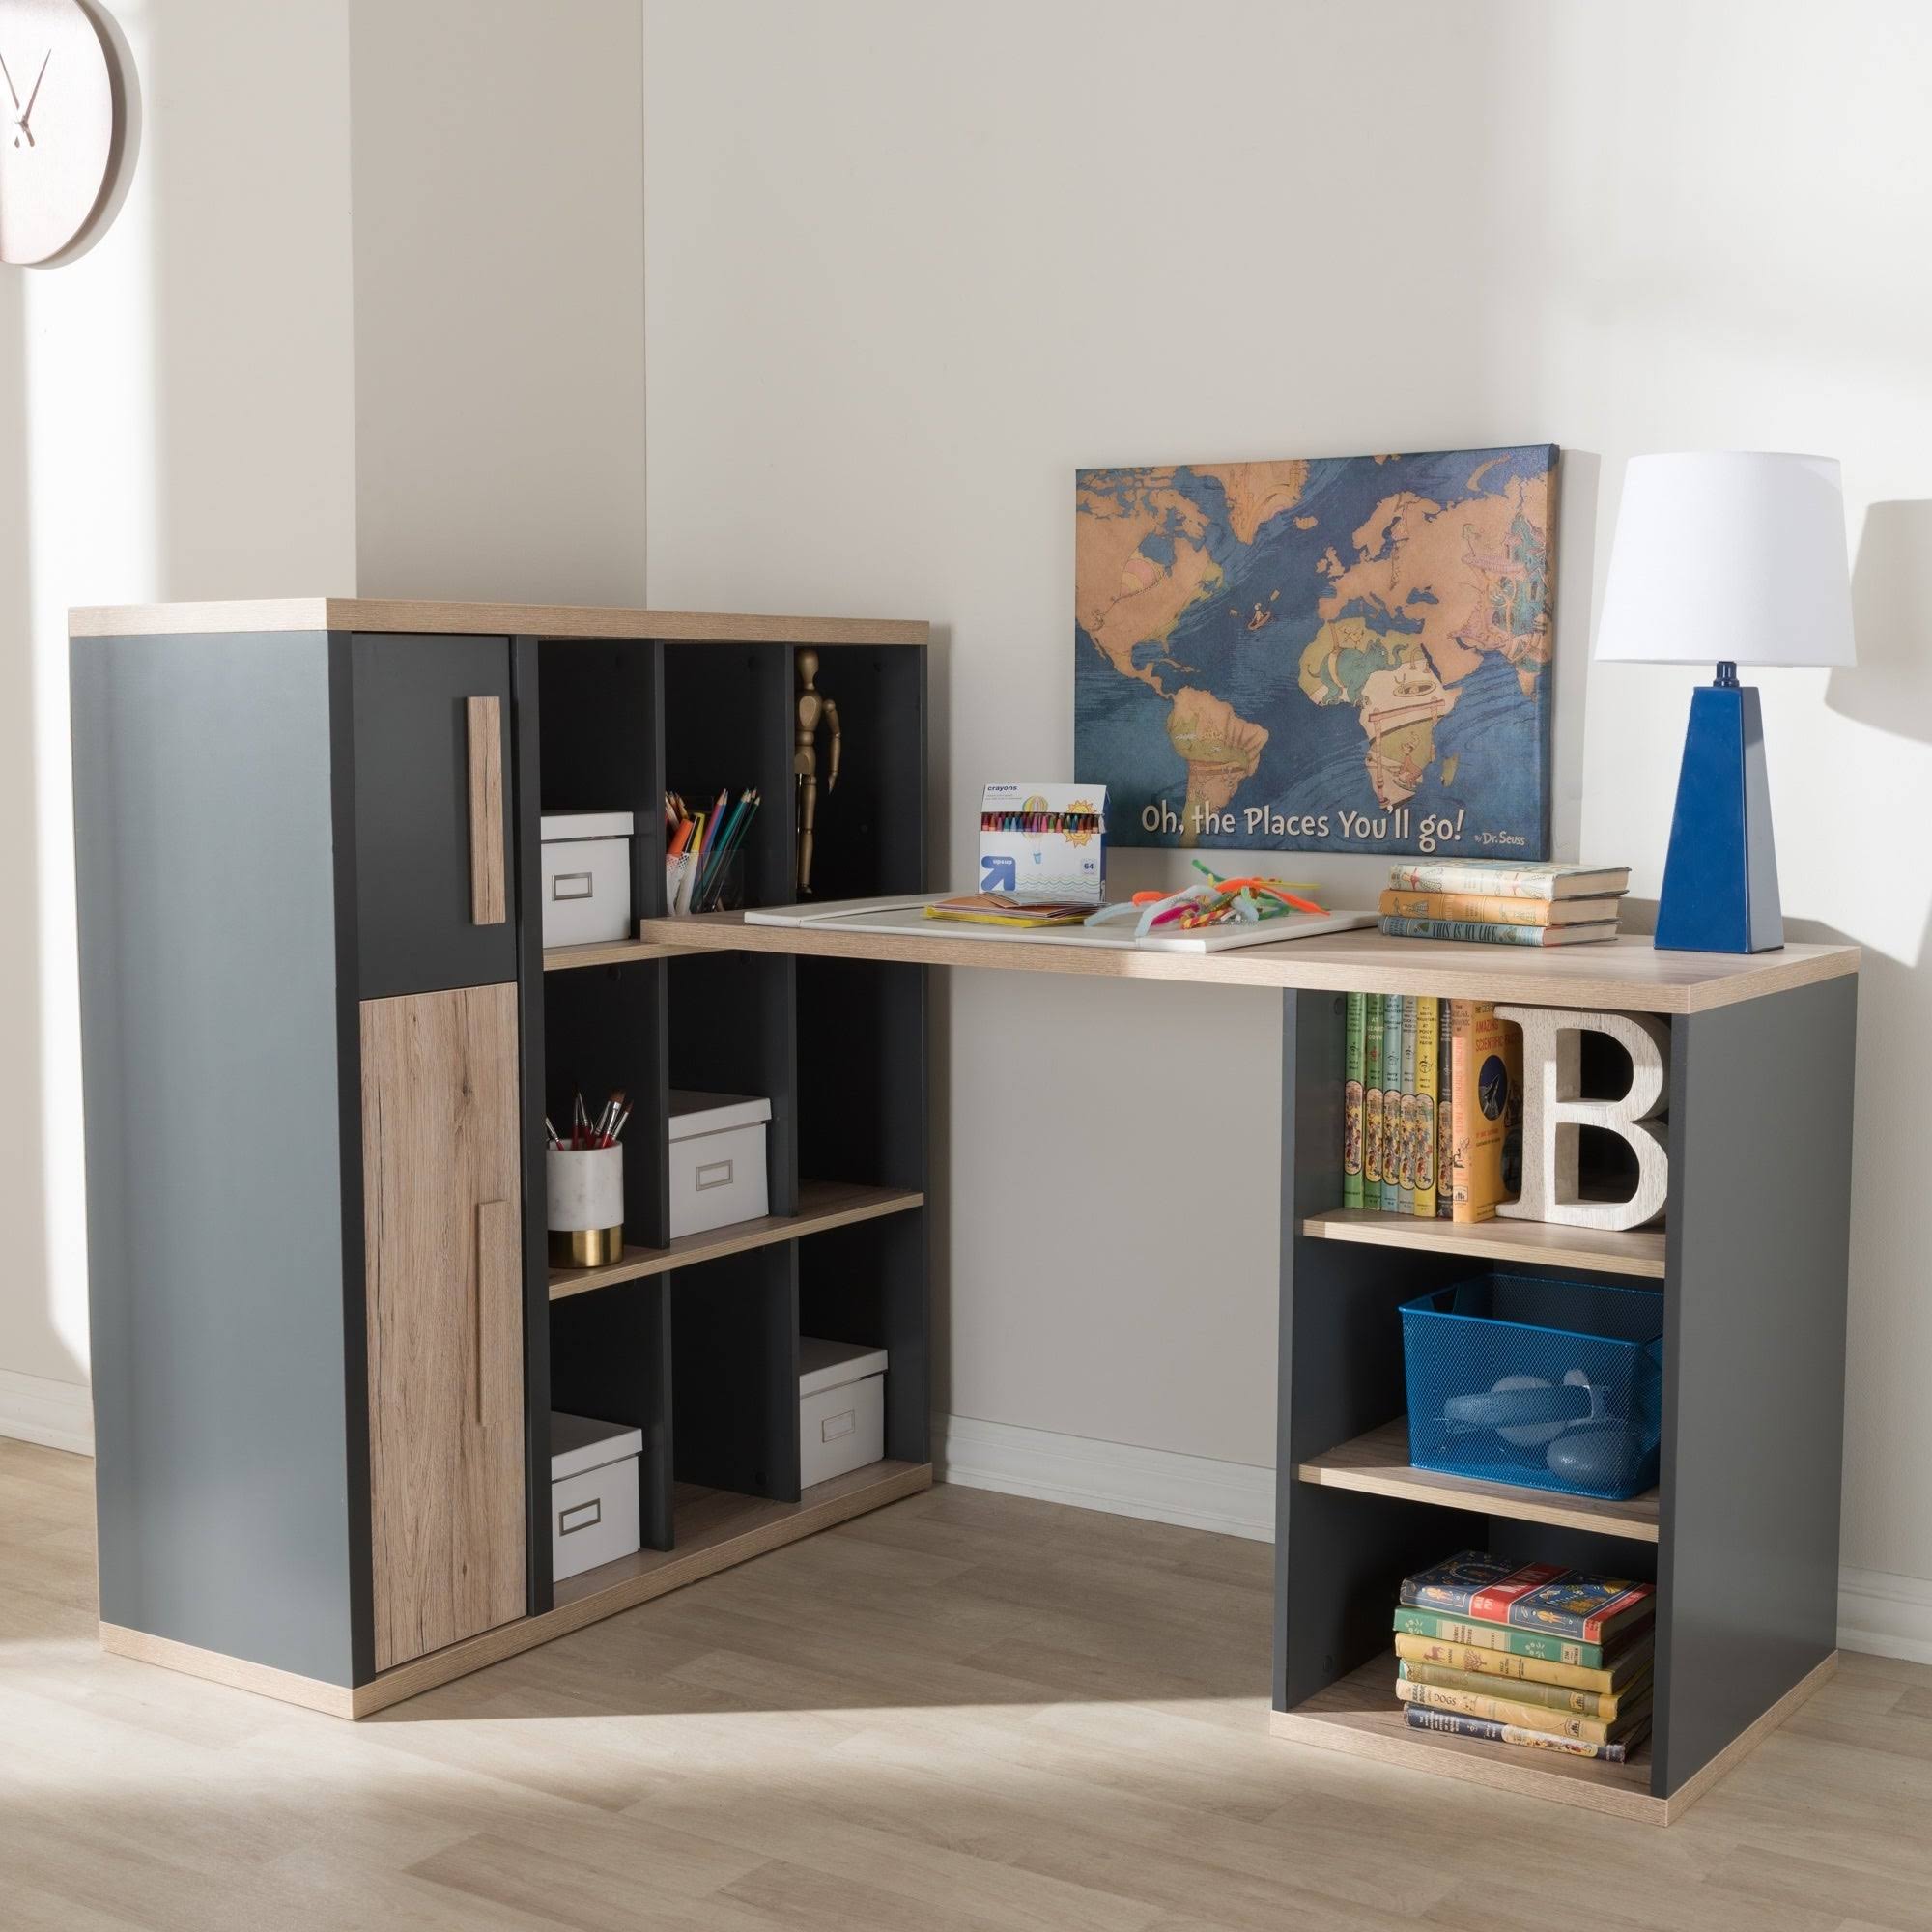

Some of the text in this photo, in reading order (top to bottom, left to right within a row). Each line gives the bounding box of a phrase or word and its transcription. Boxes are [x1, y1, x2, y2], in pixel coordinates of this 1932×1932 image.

[1141, 800, 1465, 852] Oh, the Places You'll go!
[1483, 832, 1498, 845] Dr.
[1499, 830, 1526, 846] Seuss
[1083, 862, 1094, 870] 64
[1432, 922, 1451, 938] THIS
[1452, 923, 1462, 939] IS
[1478, 925, 1498, 943] LIFE
[1475, 1019, 1499, 1033] AMAZING
[1475, 1035, 1504, 1052] SCIENTIFIC
[1435, 1693, 1457, 1706] DOGS
